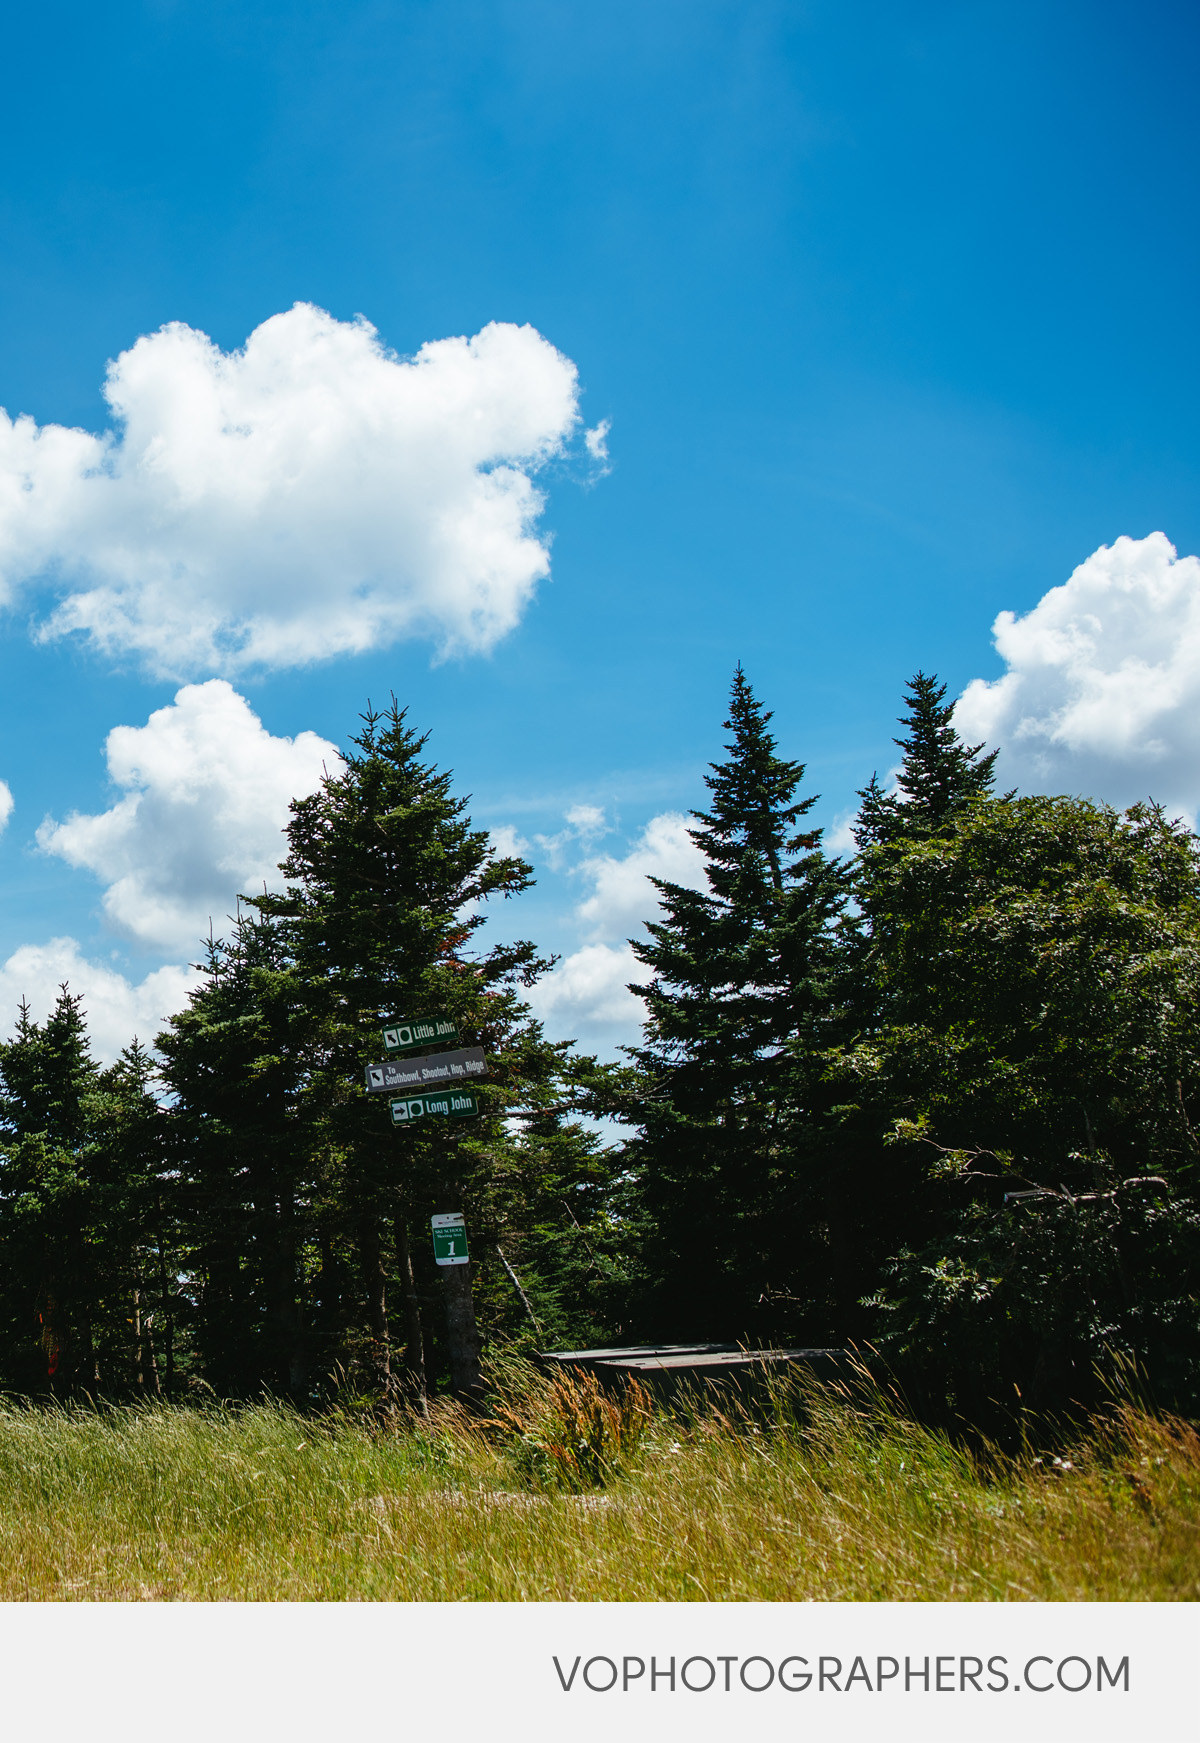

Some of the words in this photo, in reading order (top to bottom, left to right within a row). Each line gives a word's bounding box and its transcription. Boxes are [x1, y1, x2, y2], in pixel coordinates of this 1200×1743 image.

[413, 1025, 434, 1039] Little
[436, 1021, 456, 1035] John
[385, 1071, 422, 1085] Southbowl,
[450, 1063, 465, 1075] Hop,
[465, 1060, 485, 1073] Ridge
[387, 1066, 396, 1074] To
[425, 1100, 449, 1115] Long
[450, 1096, 472, 1110] John
[448, 1240, 456, 1256] 1
